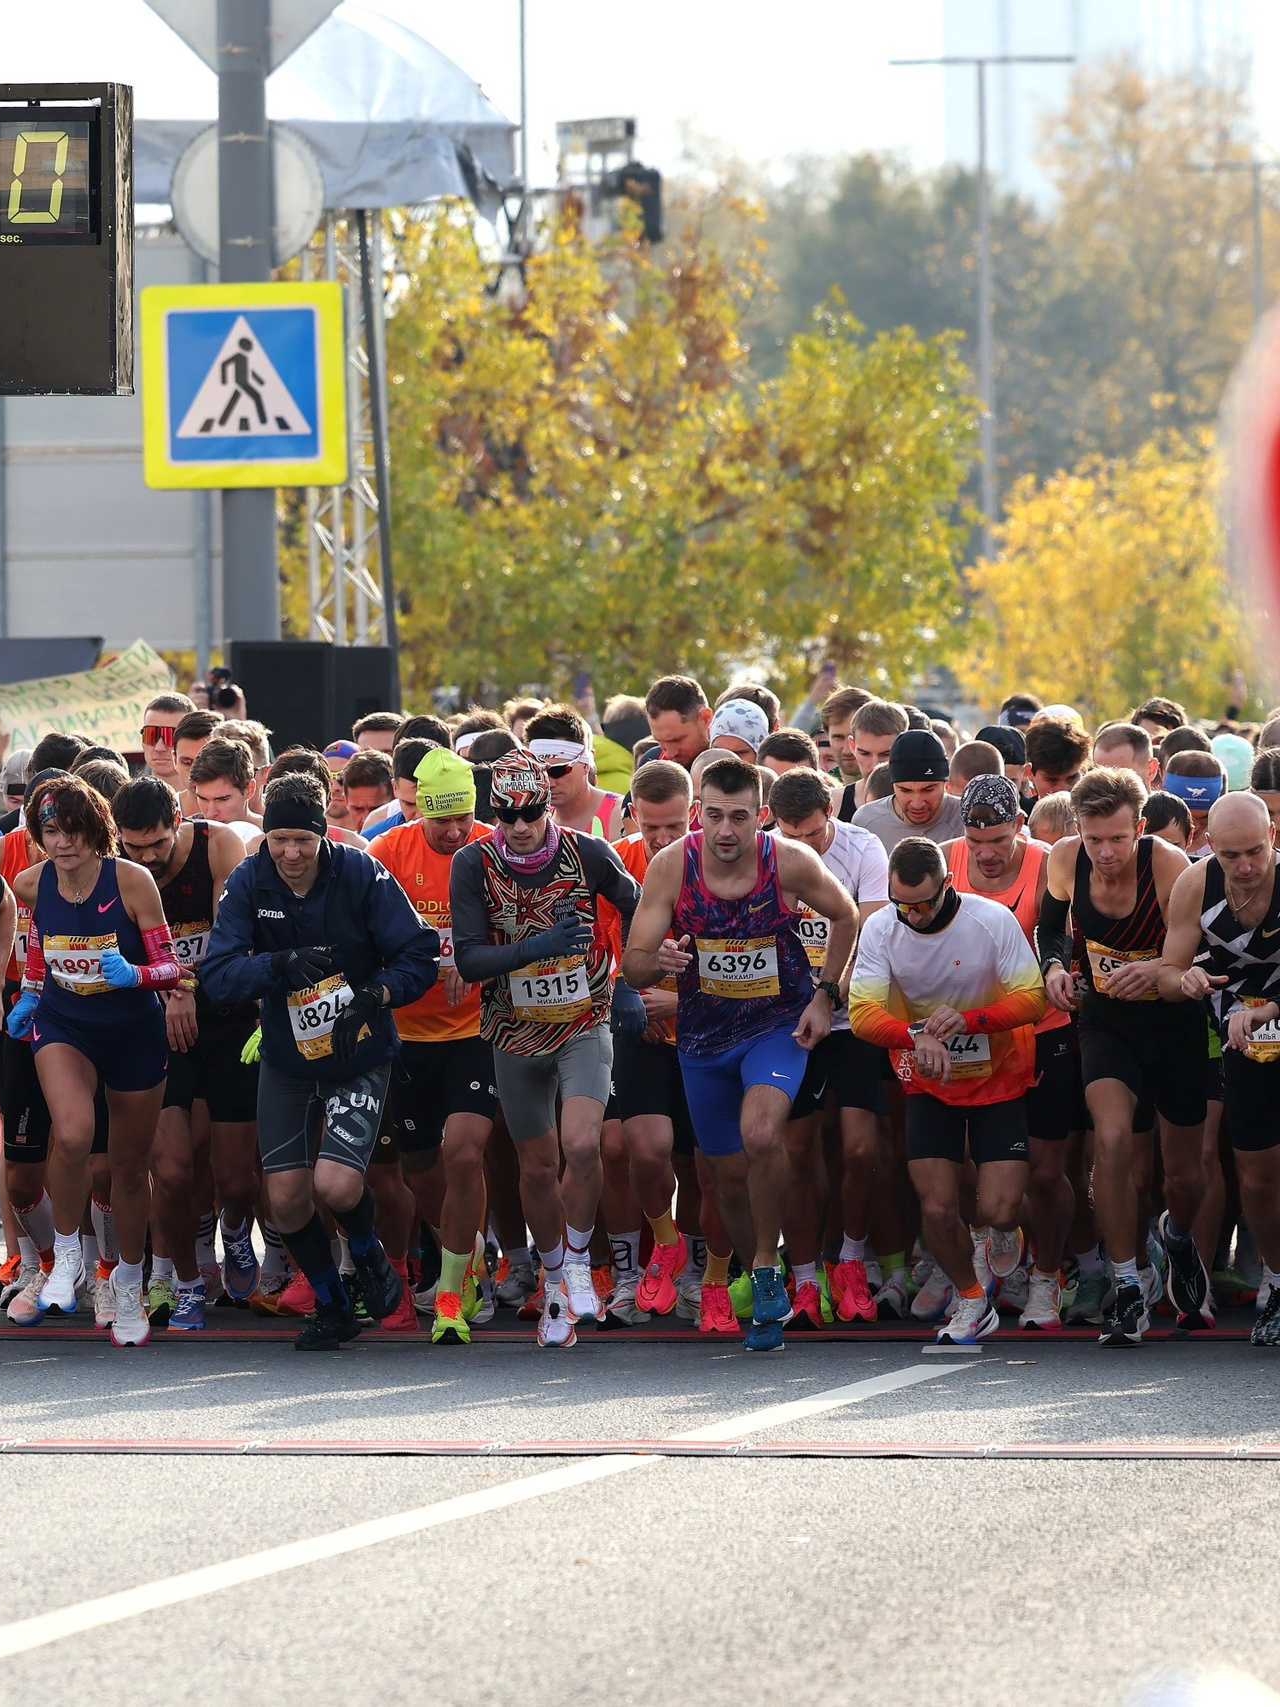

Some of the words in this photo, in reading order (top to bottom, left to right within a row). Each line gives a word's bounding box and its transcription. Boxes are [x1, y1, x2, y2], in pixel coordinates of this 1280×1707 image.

[0, 234, 23, 244] sec.
[434, 791, 471, 800] Anonymous
[435, 797, 464, 806] Running
[435, 803, 453, 811] Club
[800, 921, 828, 939] 03
[176, 936, 204, 957] 37
[707, 952, 767, 973] 6396
[522, 973, 579, 998] 1315
[537, 997, 568, 1005] МИХАИЛ
[941, 1035, 980, 1054] 44
